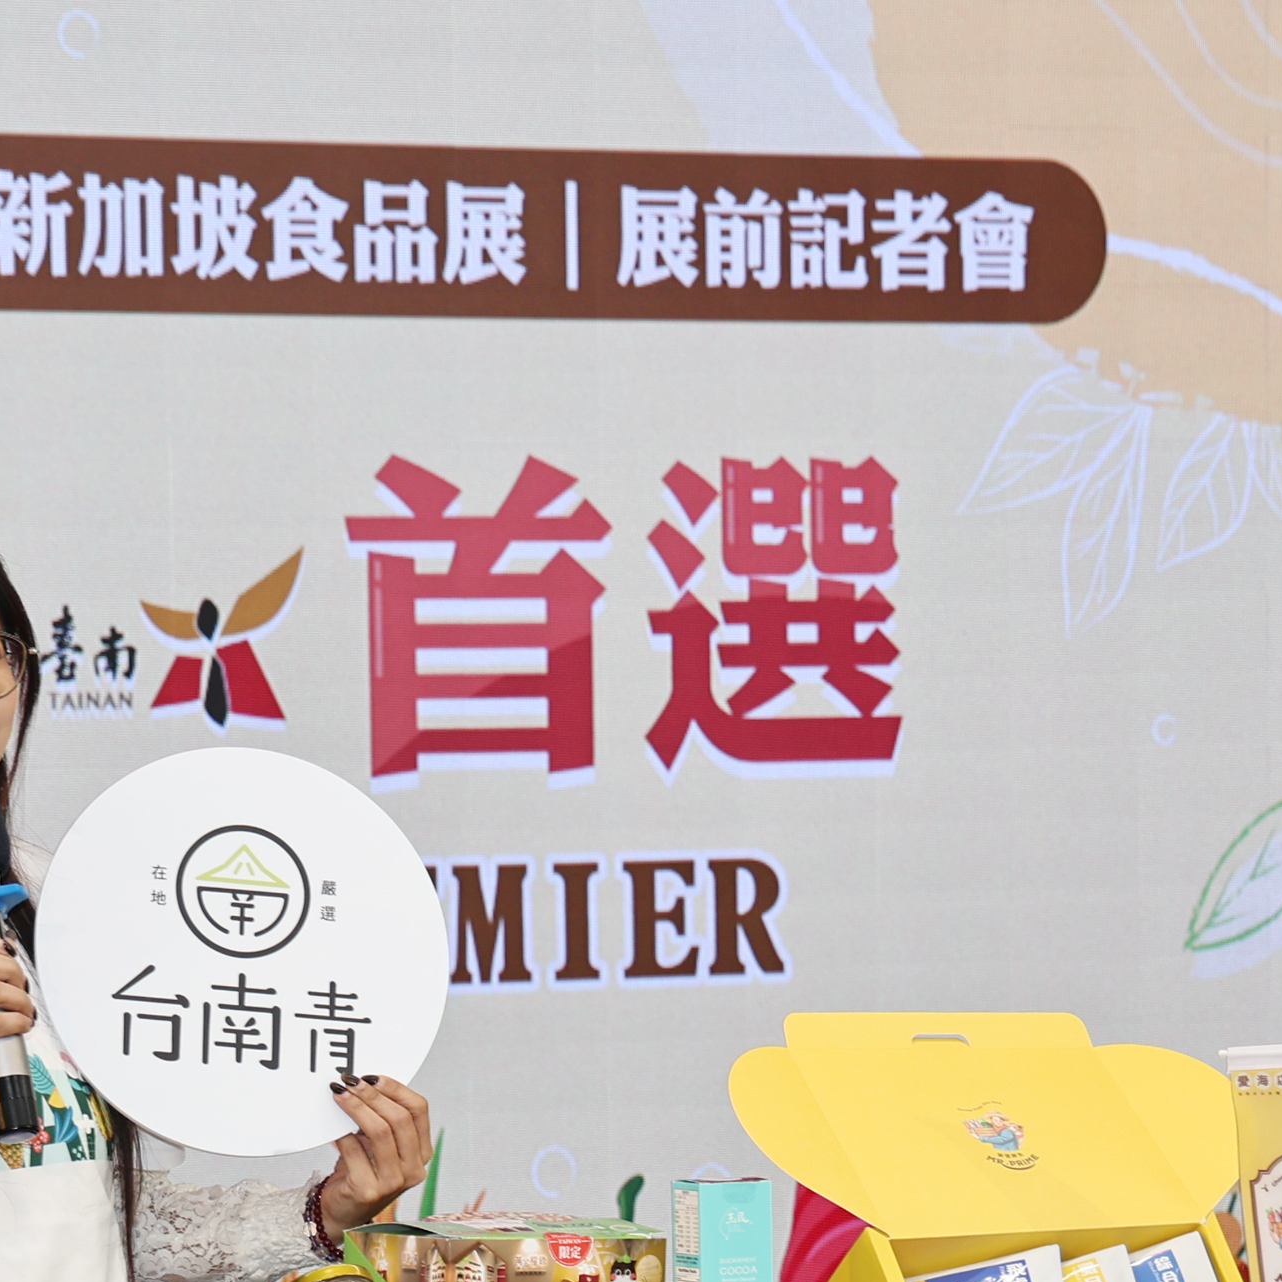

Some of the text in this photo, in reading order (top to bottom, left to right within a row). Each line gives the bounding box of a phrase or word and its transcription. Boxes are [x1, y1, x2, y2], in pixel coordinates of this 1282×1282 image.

[616, 186, 1036, 292] 展前記者會
[345, 454, 904, 780] 首選
[49, 691, 134, 711] TAINAN
[150, 864, 168, 906] 在地
[320, 879, 337, 923] 嚴選
[418, 858, 784, 984] MIER
[111, 964, 373, 1077] 台南青
[558, 1245, 582, 1260] 限定
[719, 1265, 758, 1276] COCOA
